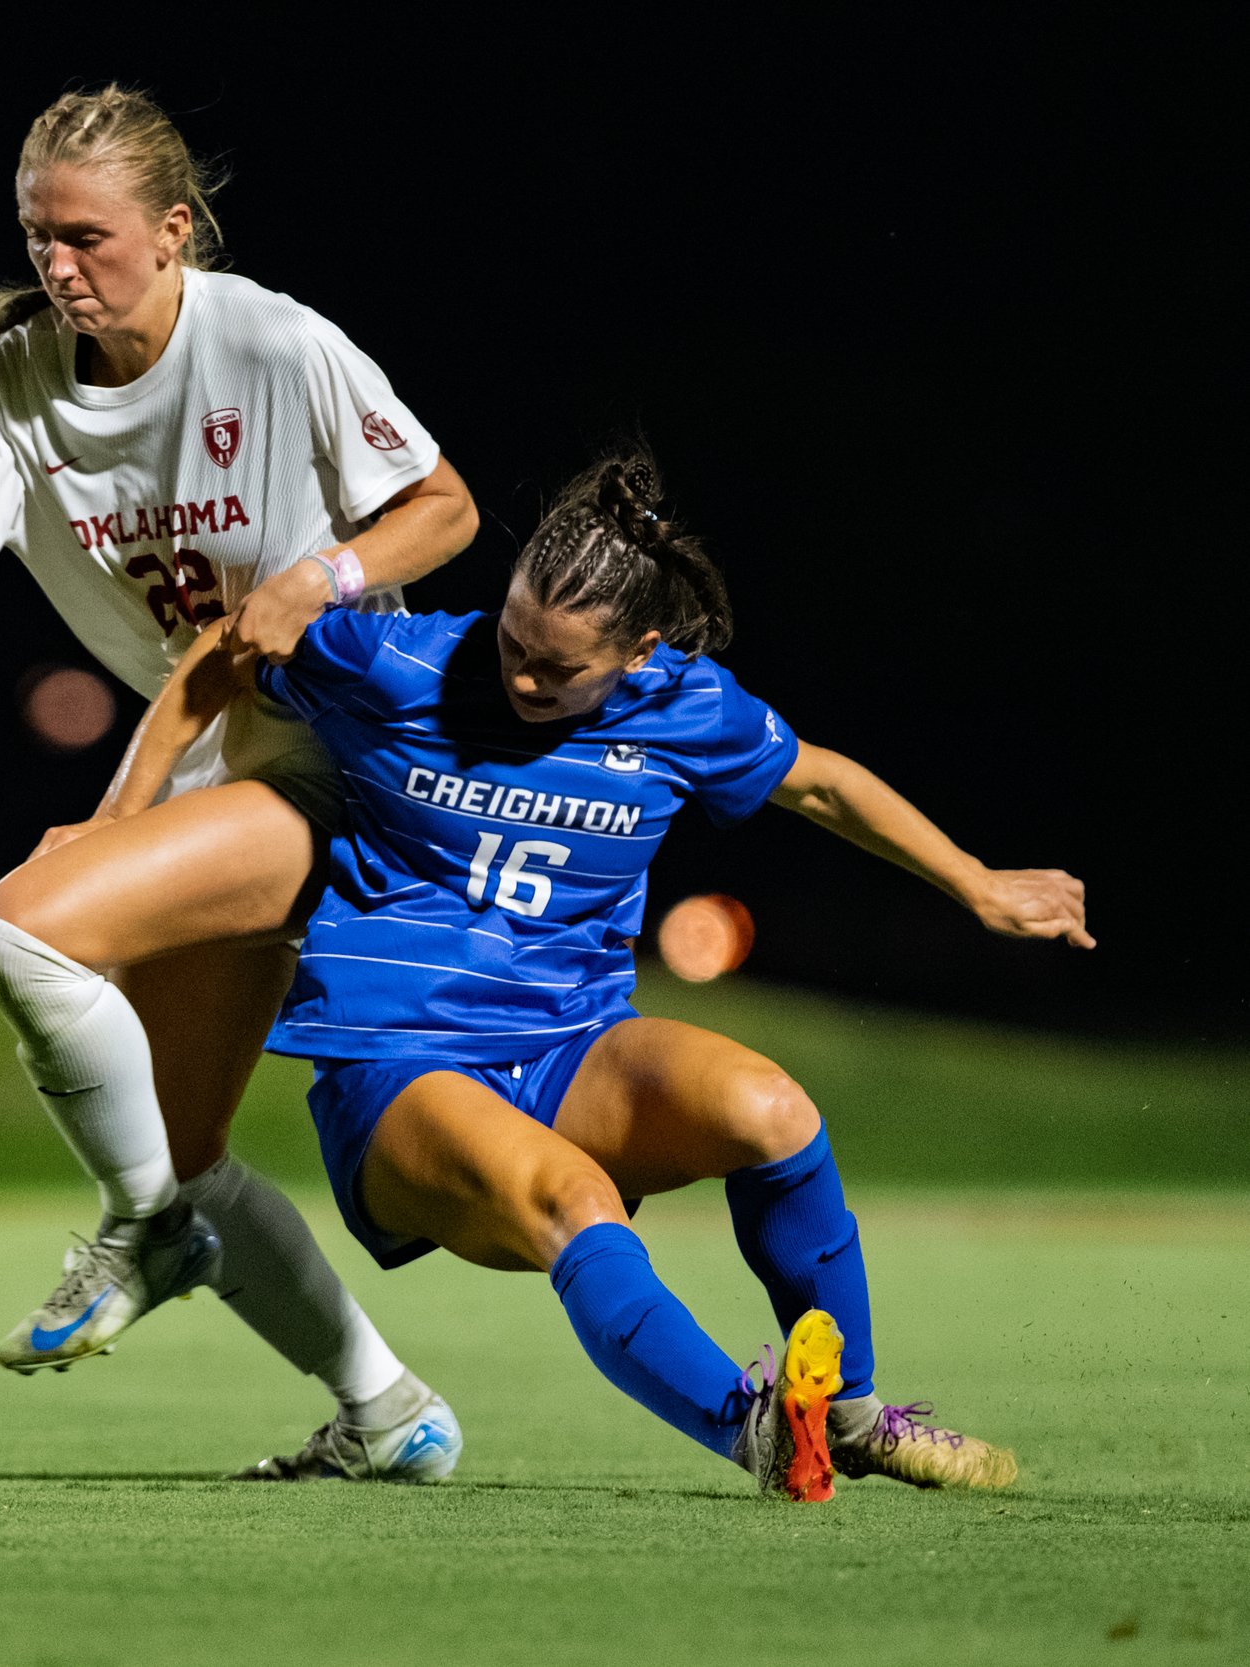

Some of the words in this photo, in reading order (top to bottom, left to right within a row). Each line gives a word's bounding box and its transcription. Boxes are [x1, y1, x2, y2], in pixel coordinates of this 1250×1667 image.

[69, 495, 250, 550] OKLAHOMA
[125, 548, 226, 638] 22
[405, 766, 642, 836] CREIGHTON
[465, 830, 572, 918] 16
